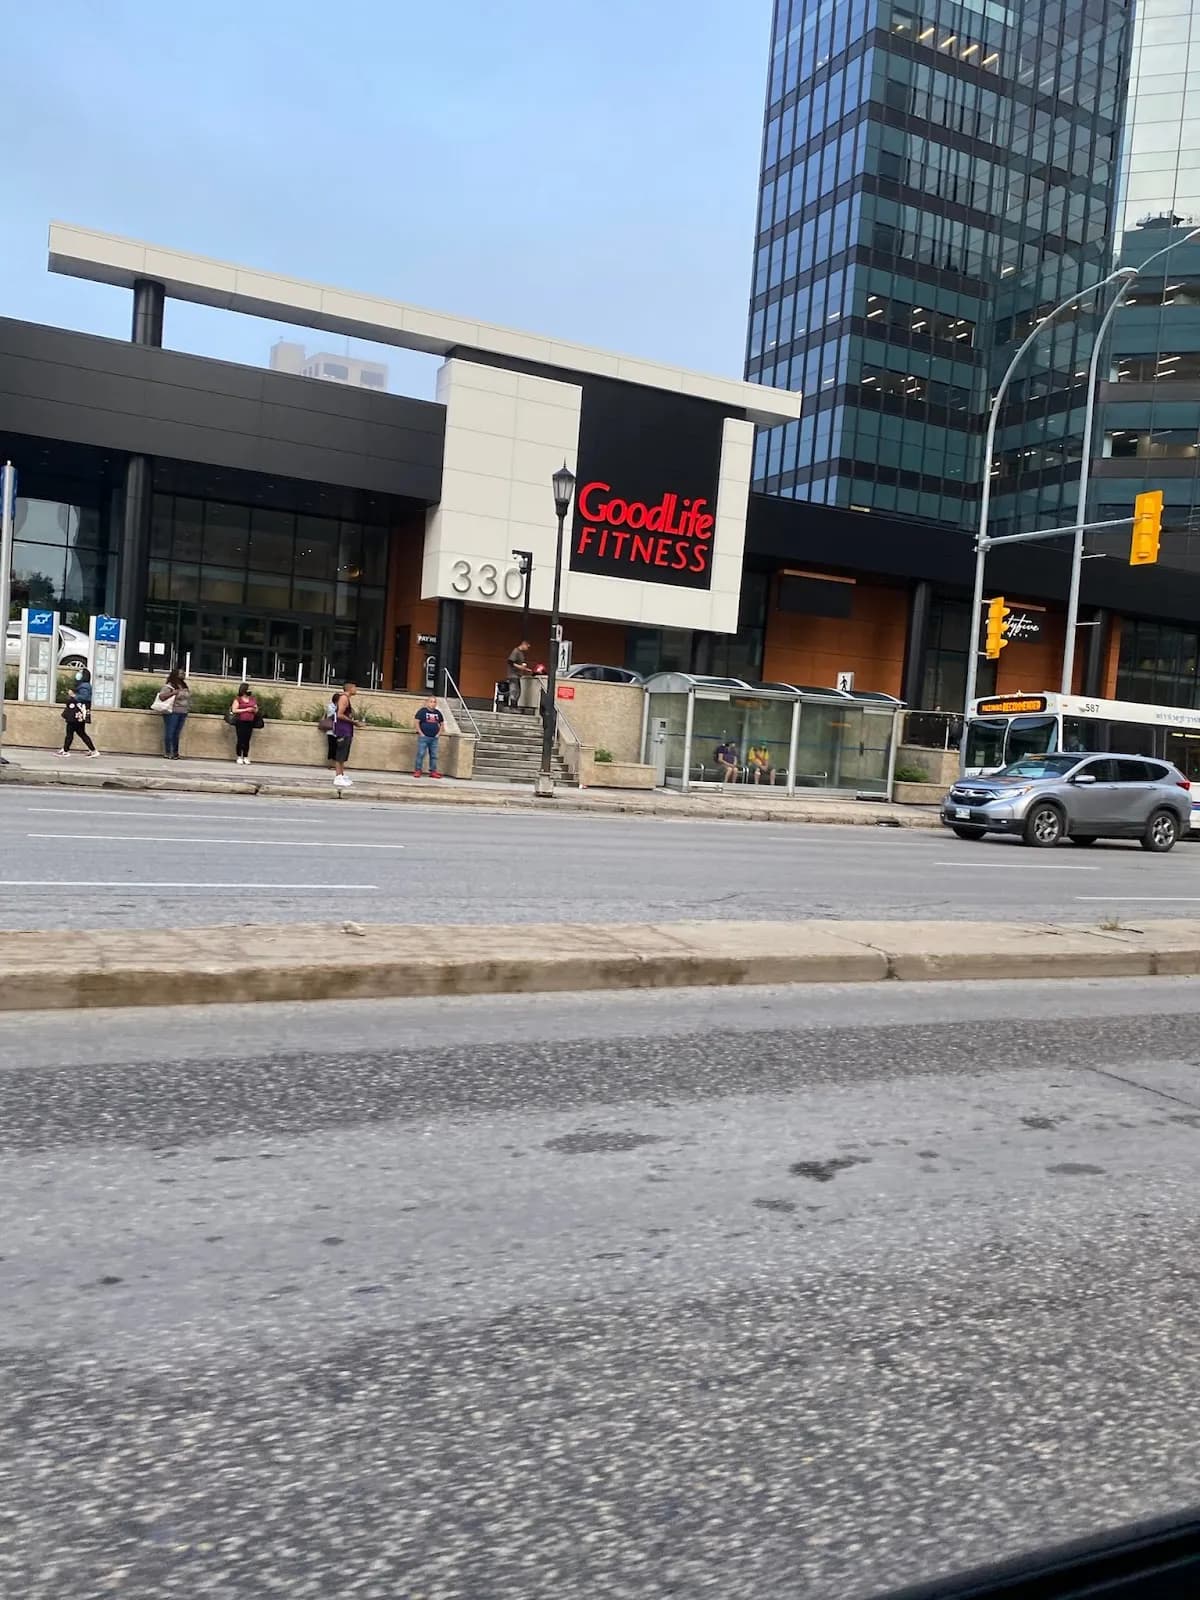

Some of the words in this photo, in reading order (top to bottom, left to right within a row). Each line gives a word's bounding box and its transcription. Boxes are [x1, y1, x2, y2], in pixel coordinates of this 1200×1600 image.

[579, 482, 714, 540] GoodLife
[577, 527, 708, 572] FITNESS
[451, 560, 524, 600] 330
[1085, 703, 1100, 713] 587
